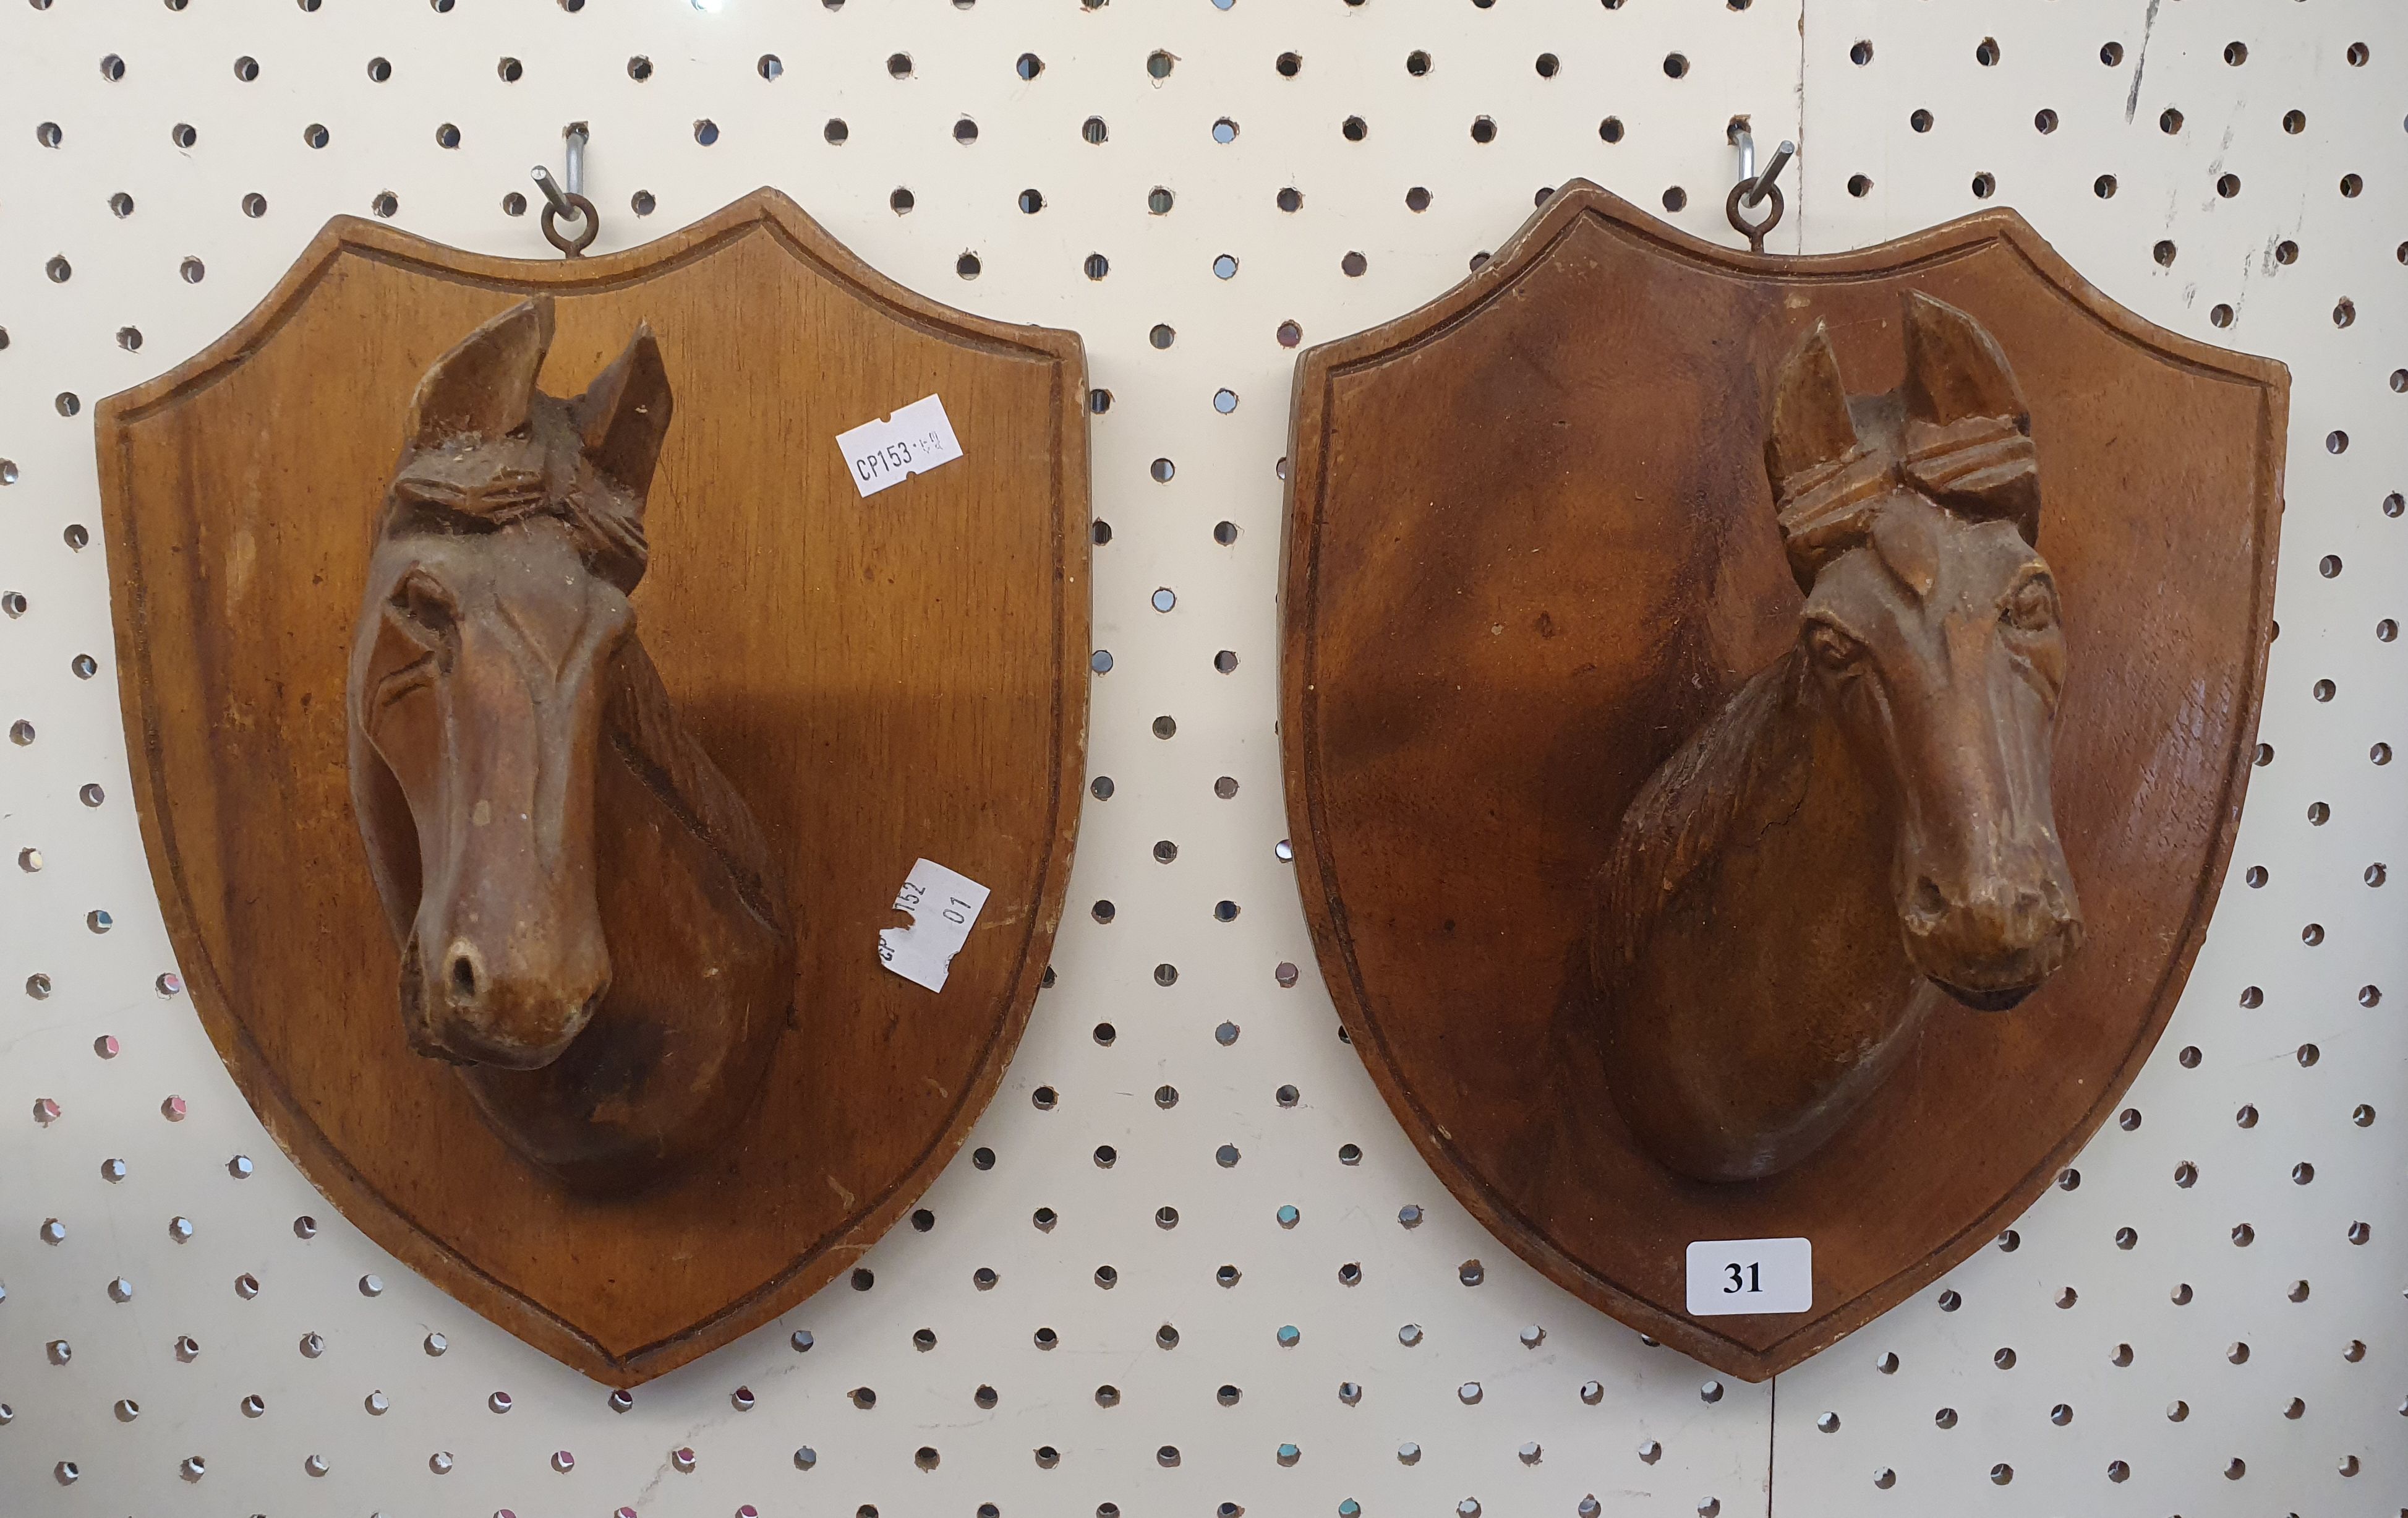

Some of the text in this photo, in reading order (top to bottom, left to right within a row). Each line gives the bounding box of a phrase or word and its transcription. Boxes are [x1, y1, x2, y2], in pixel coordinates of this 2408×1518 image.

[894, 882, 926, 911] 152
[942, 896, 971, 924] 01
[1723, 1262, 1764, 1293] 31
